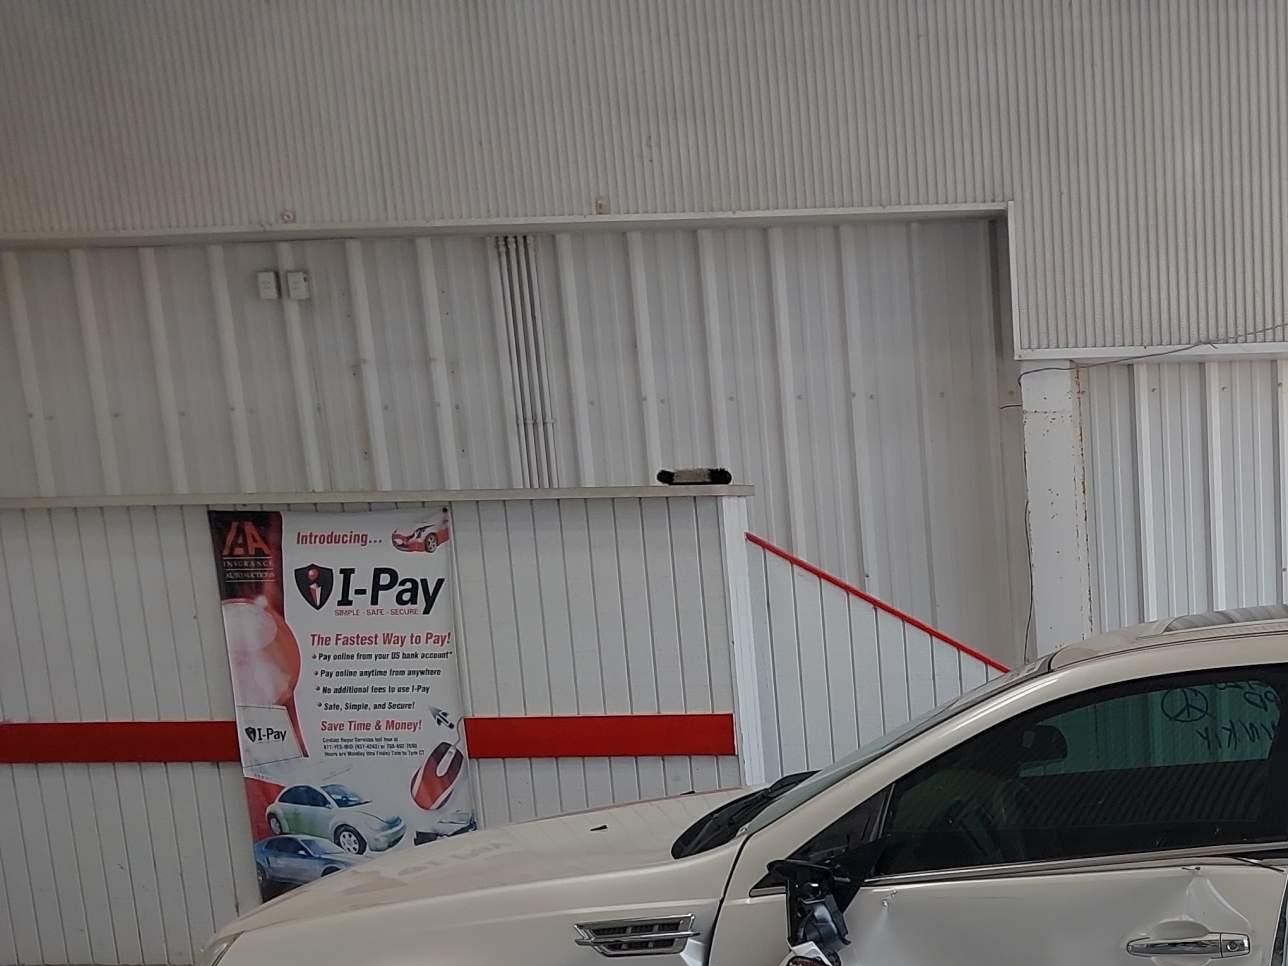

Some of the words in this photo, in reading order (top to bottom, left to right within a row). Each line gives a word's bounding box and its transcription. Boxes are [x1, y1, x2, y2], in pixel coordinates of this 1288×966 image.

[296, 531, 383, 547] Introducing...
[336, 567, 445, 615] I-Pay
[310, 634, 331, 646] The
[335, 633, 379, 646] Fastest
[382, 633, 406, 647] Way
[409, 634, 421, 645] to
[425, 632, 451, 647] Pay!
[318, 653, 331, 662] Pay
[356, 652, 372, 660] from
[374, 653, 389, 661] your
[320, 669, 333, 678] Pay
[335, 669, 357, 677] online
[359, 669, 387, 678] anytime
[407, 668, 441, 678] anywhere
[322, 686, 332, 694] No
[333, 686, 369, 694] additional
[323, 702, 342, 712] Safe,
[344, 702, 371, 713] Simple,
[373, 702, 387, 711] and
[388, 701, 415, 711] Secure!
[320, 720, 345, 732] Save
[348, 720, 372, 732] Time
[374, 721, 382, 731] &
[385, 719, 422, 733] Money!
[257, 727, 287, 742] I-Pay
